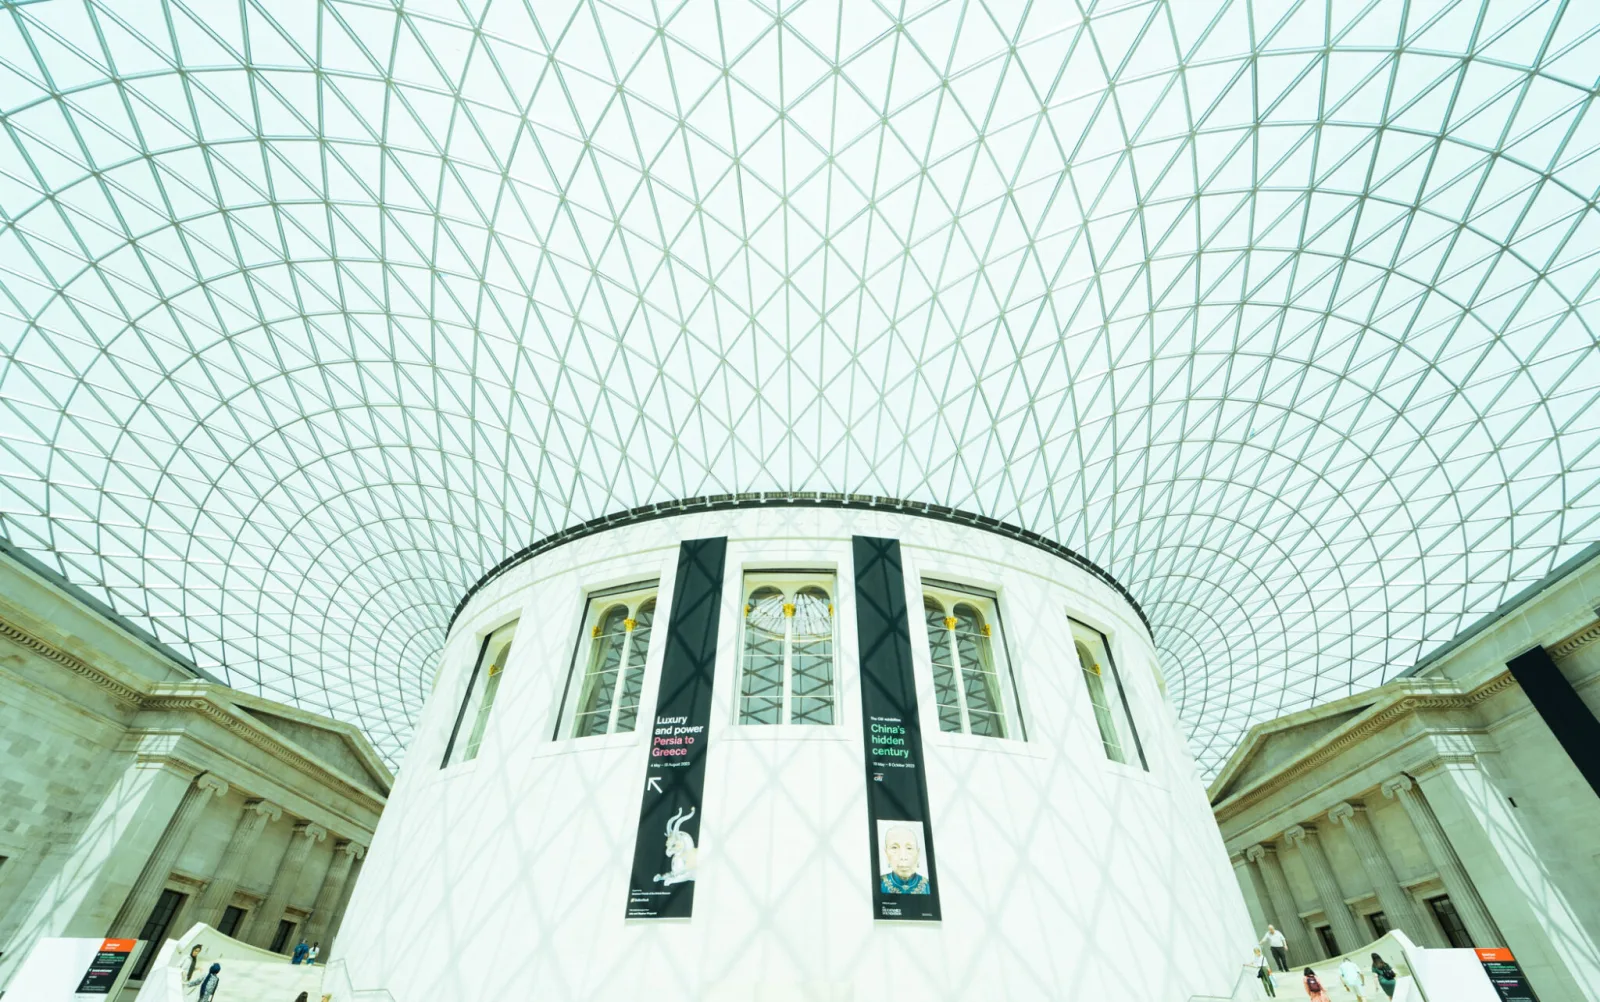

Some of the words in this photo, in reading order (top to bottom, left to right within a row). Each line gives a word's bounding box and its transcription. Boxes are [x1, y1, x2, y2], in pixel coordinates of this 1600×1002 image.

[656, 716, 688, 725] Luxury
[655, 726, 672, 735] and
[674, 726, 704, 735] power
[654, 736, 683, 746] Persia
[685, 736, 694, 744] to
[872, 735, 904, 745] hidden
[652, 747, 687, 756] Greece
[872, 748, 909, 759] century
